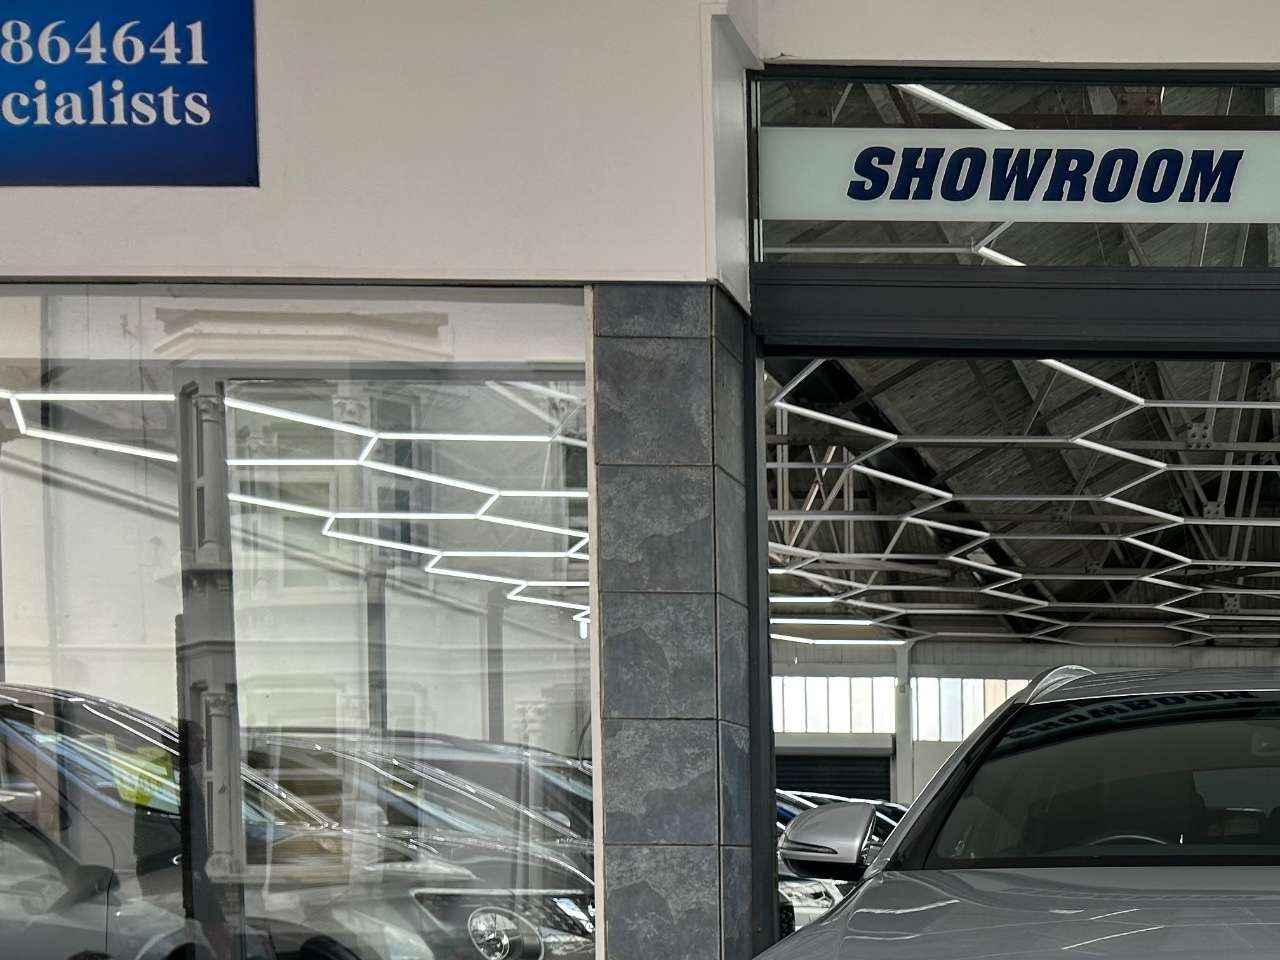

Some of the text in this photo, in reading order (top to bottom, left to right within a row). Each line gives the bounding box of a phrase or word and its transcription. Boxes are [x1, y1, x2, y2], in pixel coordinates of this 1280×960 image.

[1, 20, 208, 65] 864641
[2, 79, 210, 126] cialists
[847, 147, 1244, 203] SHOWROOM
